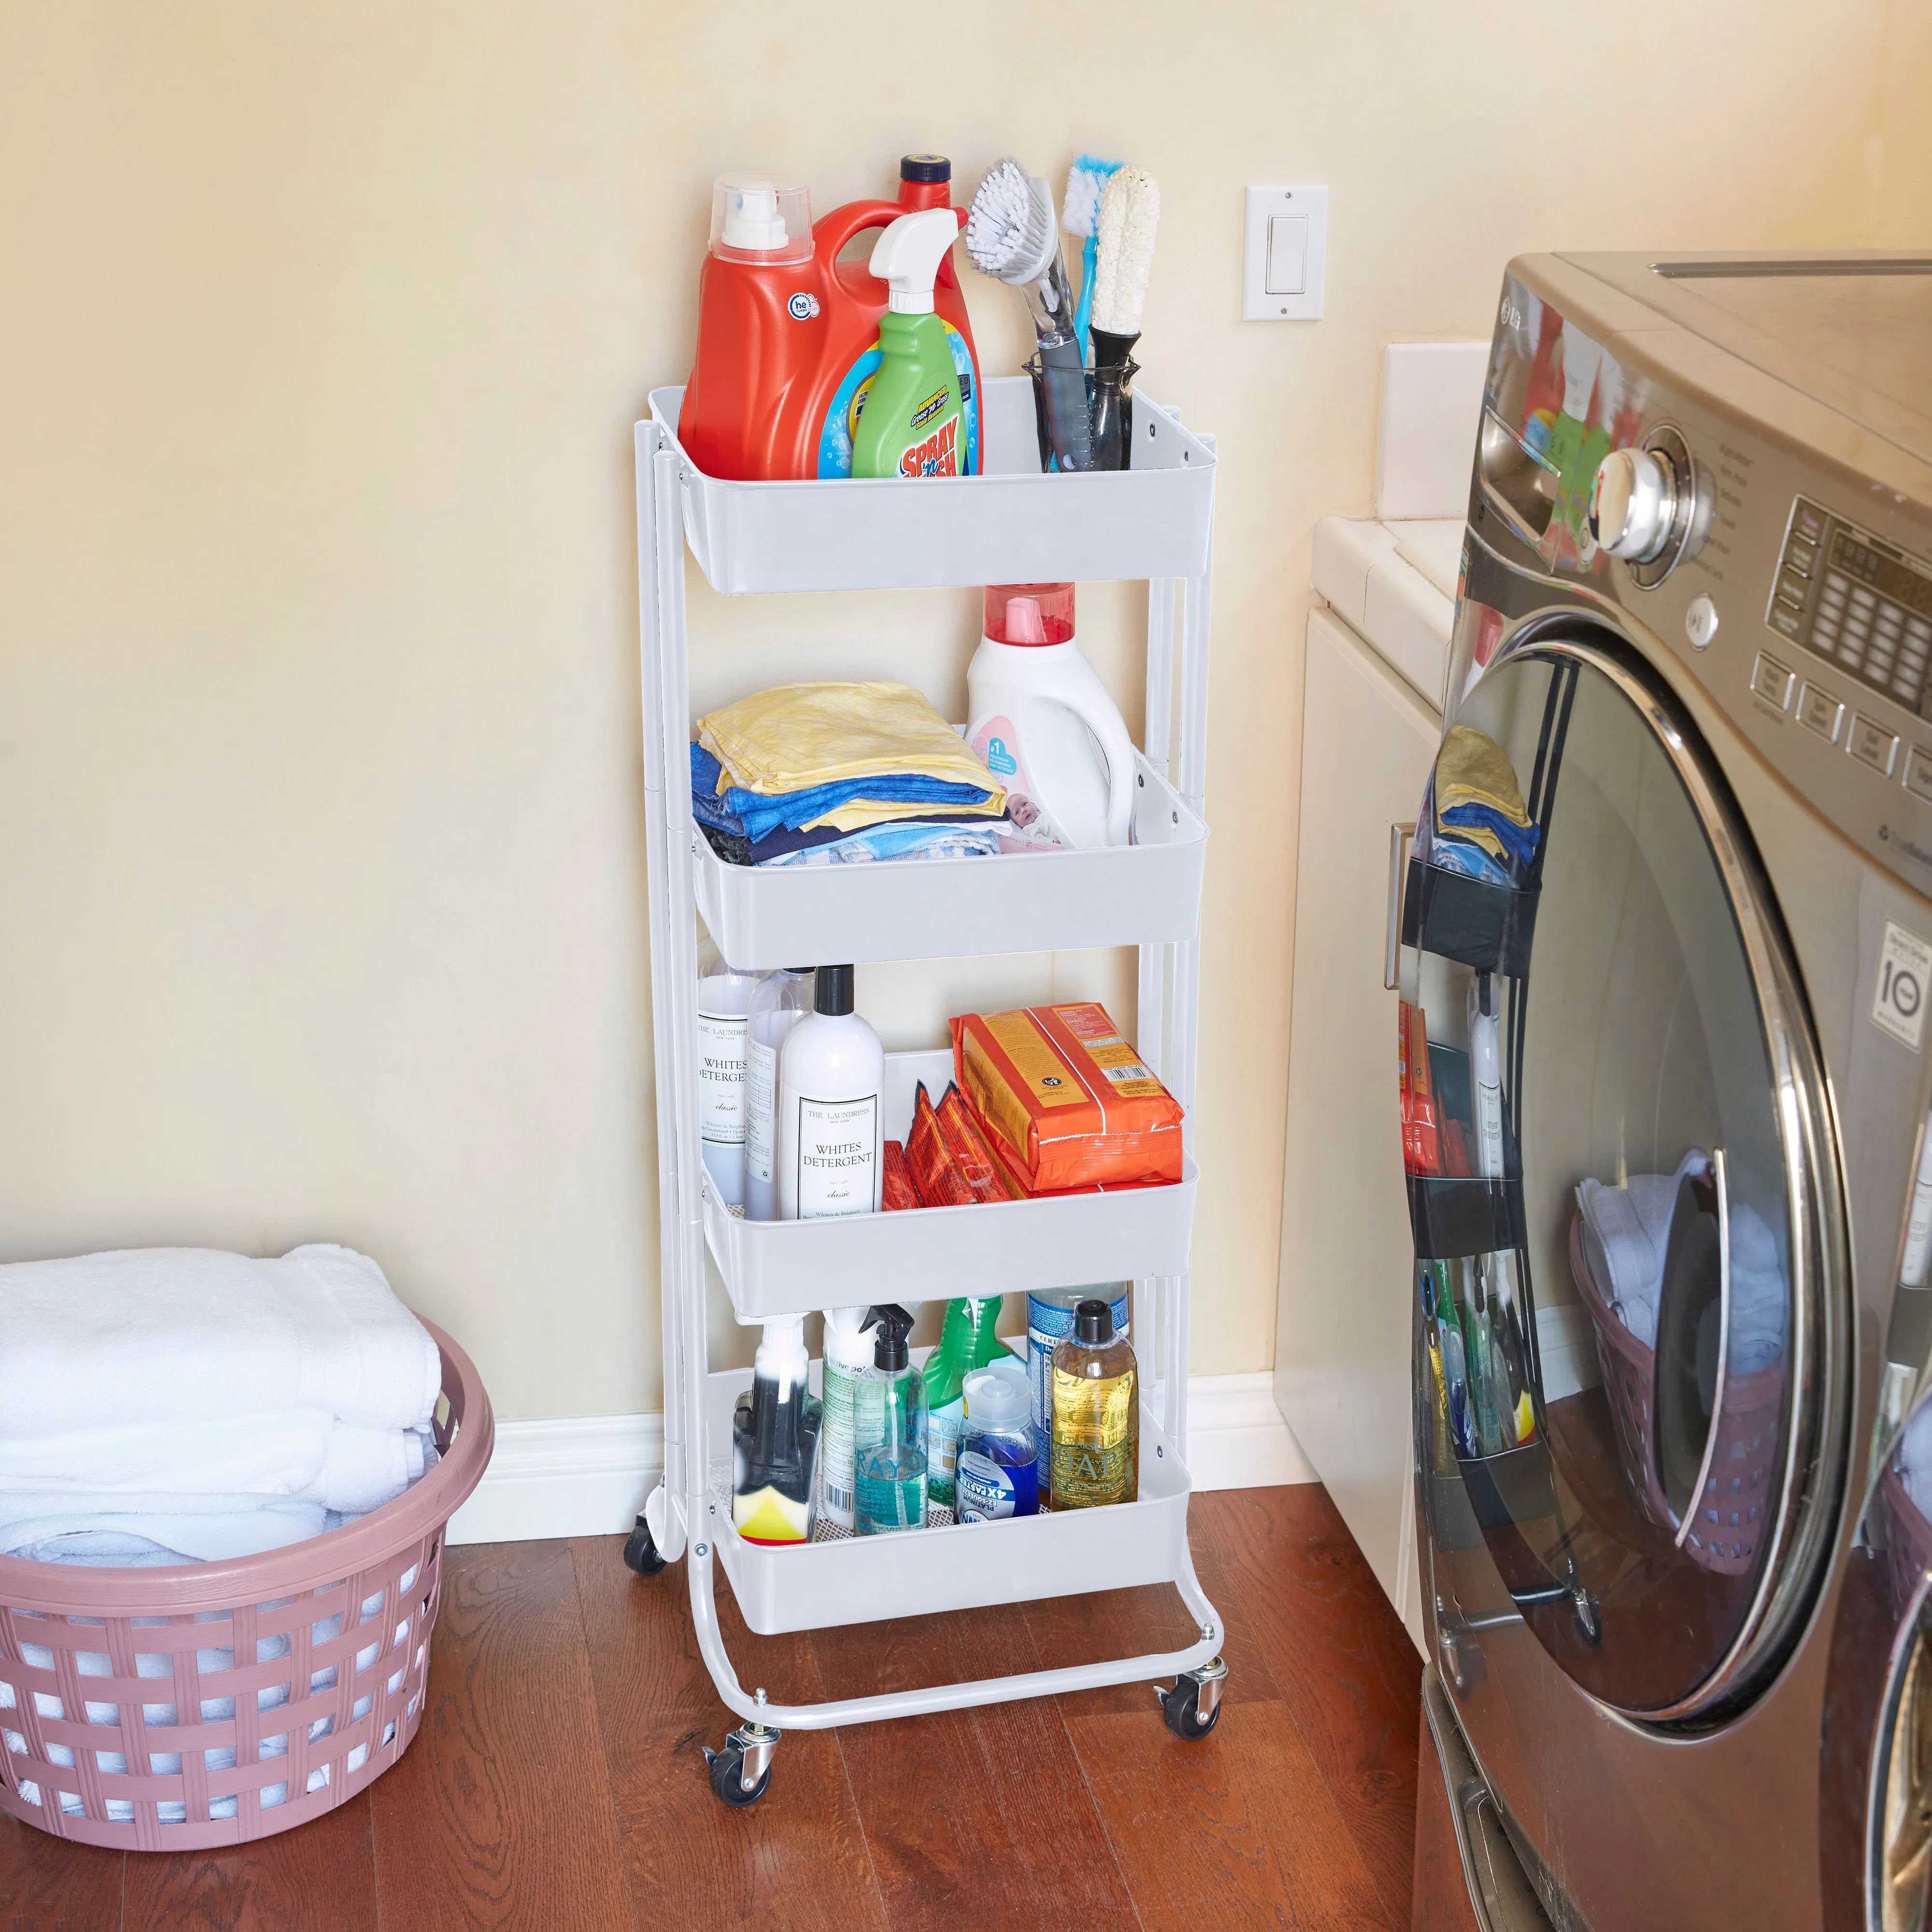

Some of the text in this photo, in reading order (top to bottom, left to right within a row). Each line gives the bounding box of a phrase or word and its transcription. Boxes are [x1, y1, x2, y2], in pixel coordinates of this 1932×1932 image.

[795, 301, 807, 309] he
[918, 385, 947, 413] ADVANCED
[911, 409, 928, 426] Grease
[938, 393, 949, 407] Grass
[916, 405, 944, 429] Stain Removal
[903, 416, 958, 478] SPRAY
[990, 754, 1009, 763] PEDIATRICIAN
[990, 758, 1011, 768] RECOMMENDED
[997, 765, 1014, 773] DETERGENT
[704, 1057, 747, 1069] WHITES
[699, 1069, 747, 1082] ETERGE
[827, 1108, 870, 1119] LAUNDRESS
[816, 1142, 861, 1154] WHITES
[804, 1152, 872, 1167] DETERGENT
[827, 1190, 850, 1198] classic
[1040, 1335, 1057, 1344] CERT
[960, 1473, 1007, 1499] 4X FASTER
[962, 1488, 997, 1506] EZ-SQUEEZE
[964, 1494, 994, 1511] PLATINUM
